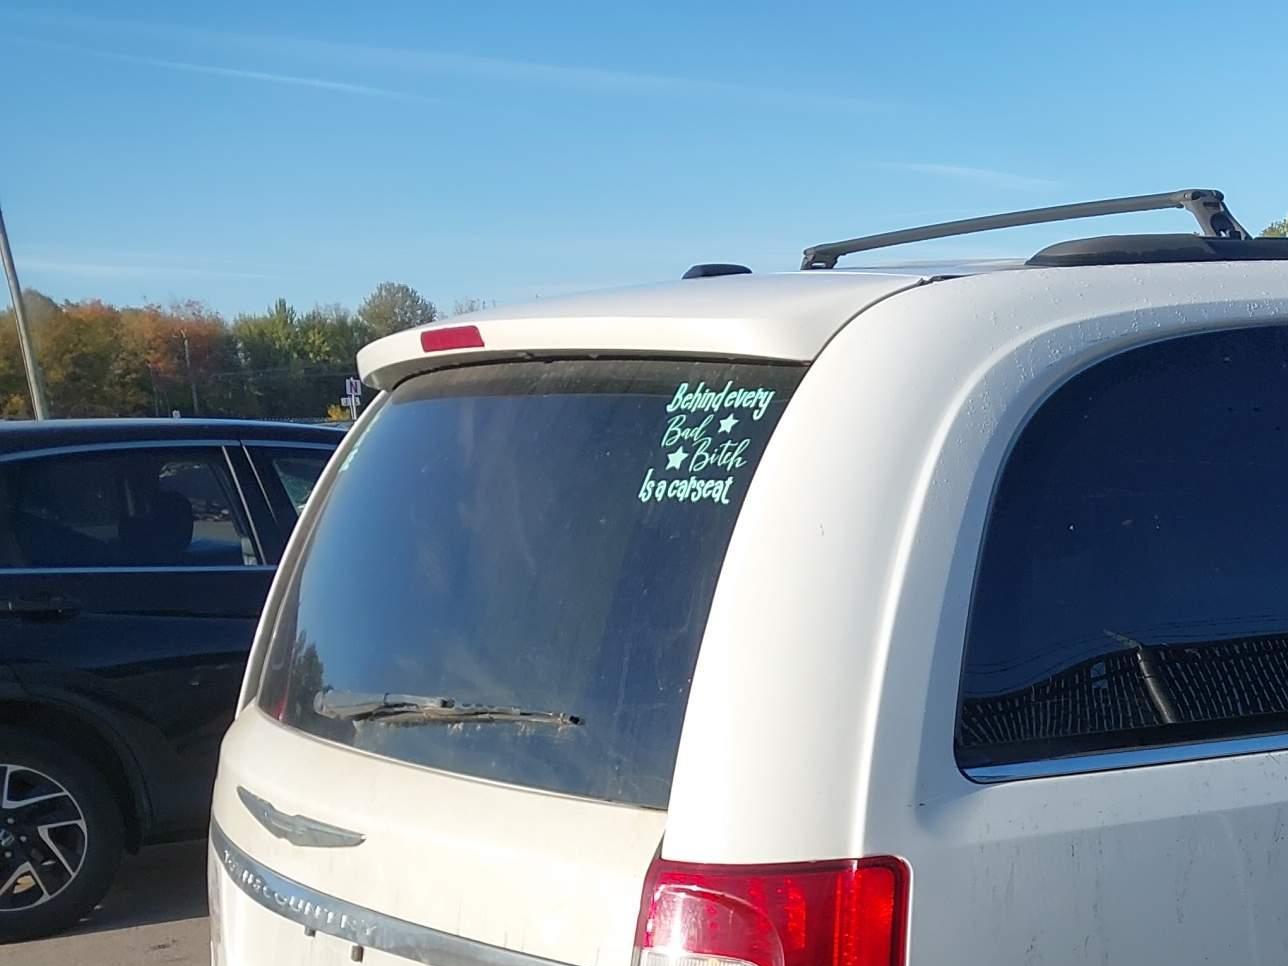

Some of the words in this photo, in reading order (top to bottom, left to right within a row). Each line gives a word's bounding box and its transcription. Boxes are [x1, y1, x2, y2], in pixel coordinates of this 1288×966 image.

[661, 414, 714, 447] Bad
[688, 437, 751, 472] Bitch
[667, 476, 733, 504] carseat
